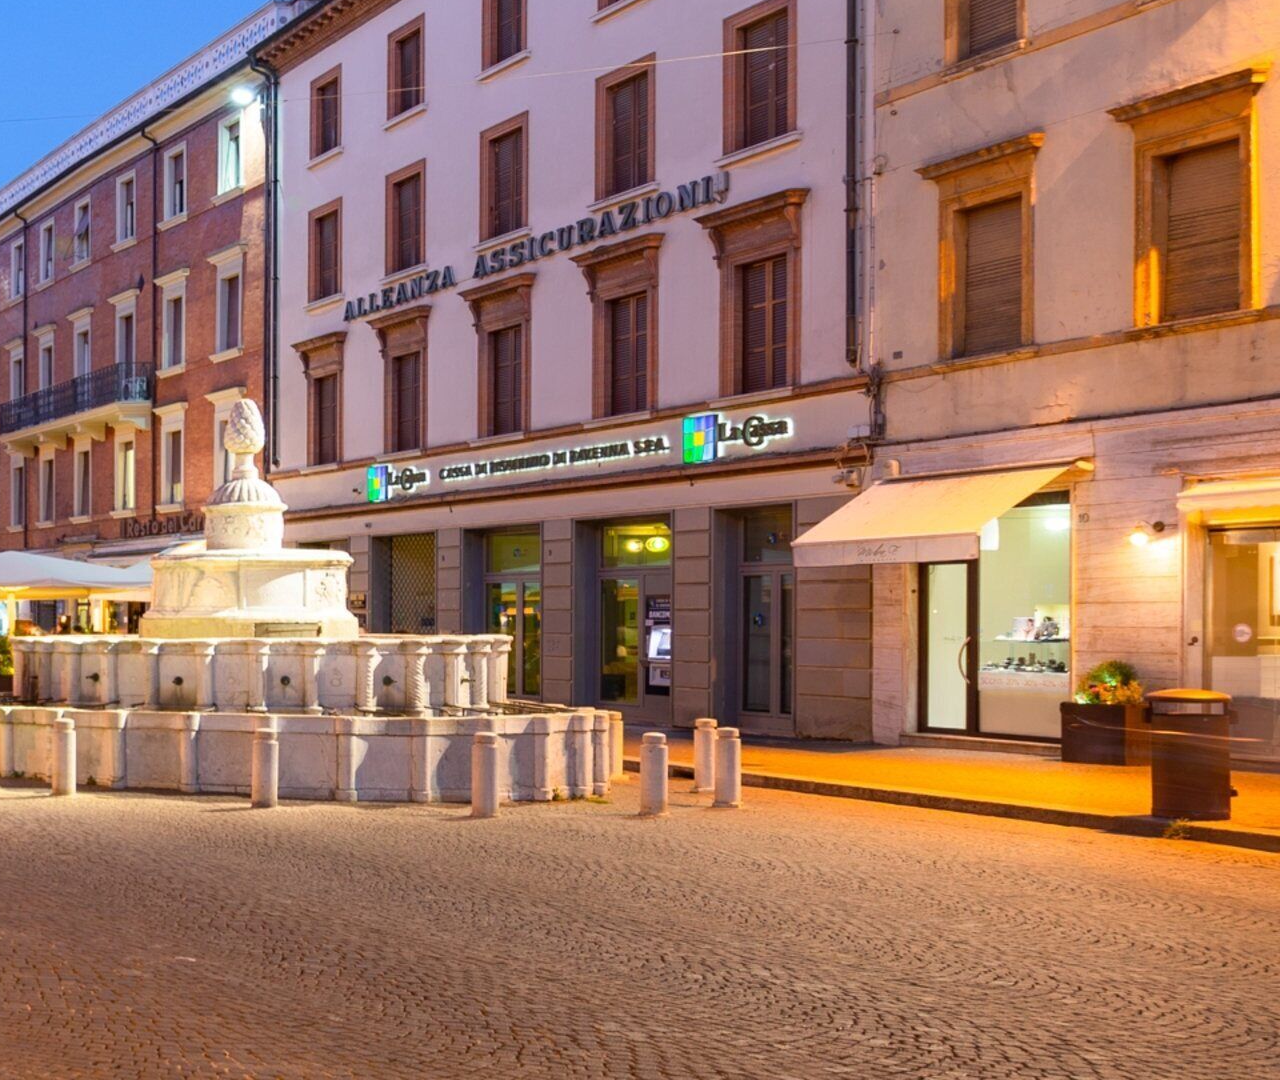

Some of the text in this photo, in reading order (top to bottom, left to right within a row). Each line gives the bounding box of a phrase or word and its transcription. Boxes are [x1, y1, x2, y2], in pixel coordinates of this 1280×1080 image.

[343, 175, 714, 321] ALLEANZA ASSICURAZIONI
[718, 416, 789, 447] La Cassa
[439, 465, 472, 480] CASSA
[474, 462, 488, 475] DI
[552, 451, 567, 466] DI
[569, 443, 630, 463] RAVENNA
[126, 518, 158, 537] Resto
[161, 513, 177, 533] del
[180, 512, 205, 531] Car
[1078, 512, 1090, 524] 10
